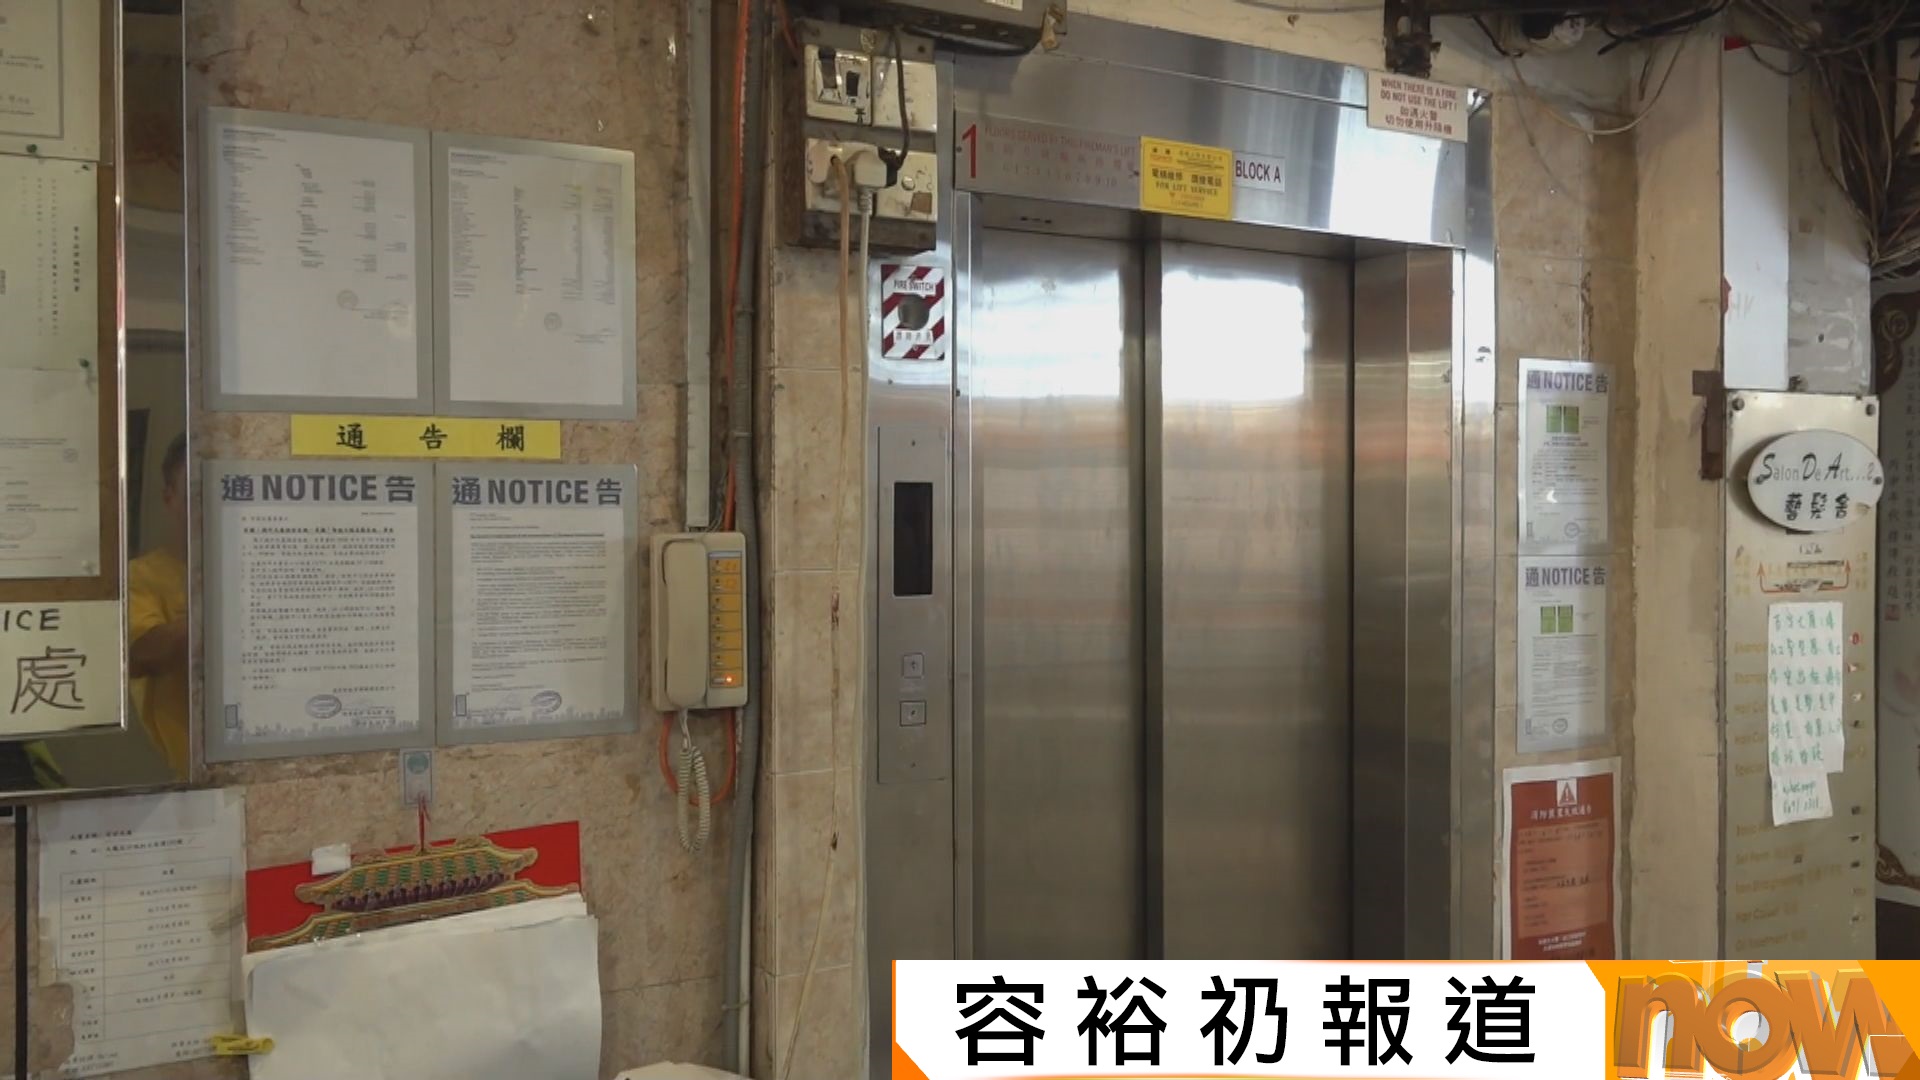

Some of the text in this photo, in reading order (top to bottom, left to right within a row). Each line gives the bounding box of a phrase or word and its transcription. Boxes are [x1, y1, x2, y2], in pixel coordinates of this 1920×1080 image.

[1380, 89, 1391, 100] DO
[1392, 91, 1406, 102] NOT
[1407, 94, 1422, 105] USE
[1424, 97, 1437, 108] THE
[1438, 99, 1453, 111] LIFT
[1381, 78, 1457, 99] WHEN THERE IS A FIRE
[962, 123, 977, 179] 1
[1235, 160, 1282, 183] BLOCK A
[1155, 181, 1170, 190] FOR
[1172, 183, 1187, 193] LIFT
[894, 280, 934, 291] FIRE SWITCH
[1543, 371, 1592, 391] NOTICE
[1595, 374, 1608, 393] 告
[335, 423, 525, 451] 通告欄
[1756, 453, 1799, 483] Salon
[1802, 452, 1821, 481] De
[221, 474, 416, 502] 通 NOTICE 告
[452, 476, 622, 505] 通 NOTICE 告
[1542, 567, 1590, 585] NOTICE
[1593, 566, 1606, 586] 告
[11, 645, 87, 715] 處
